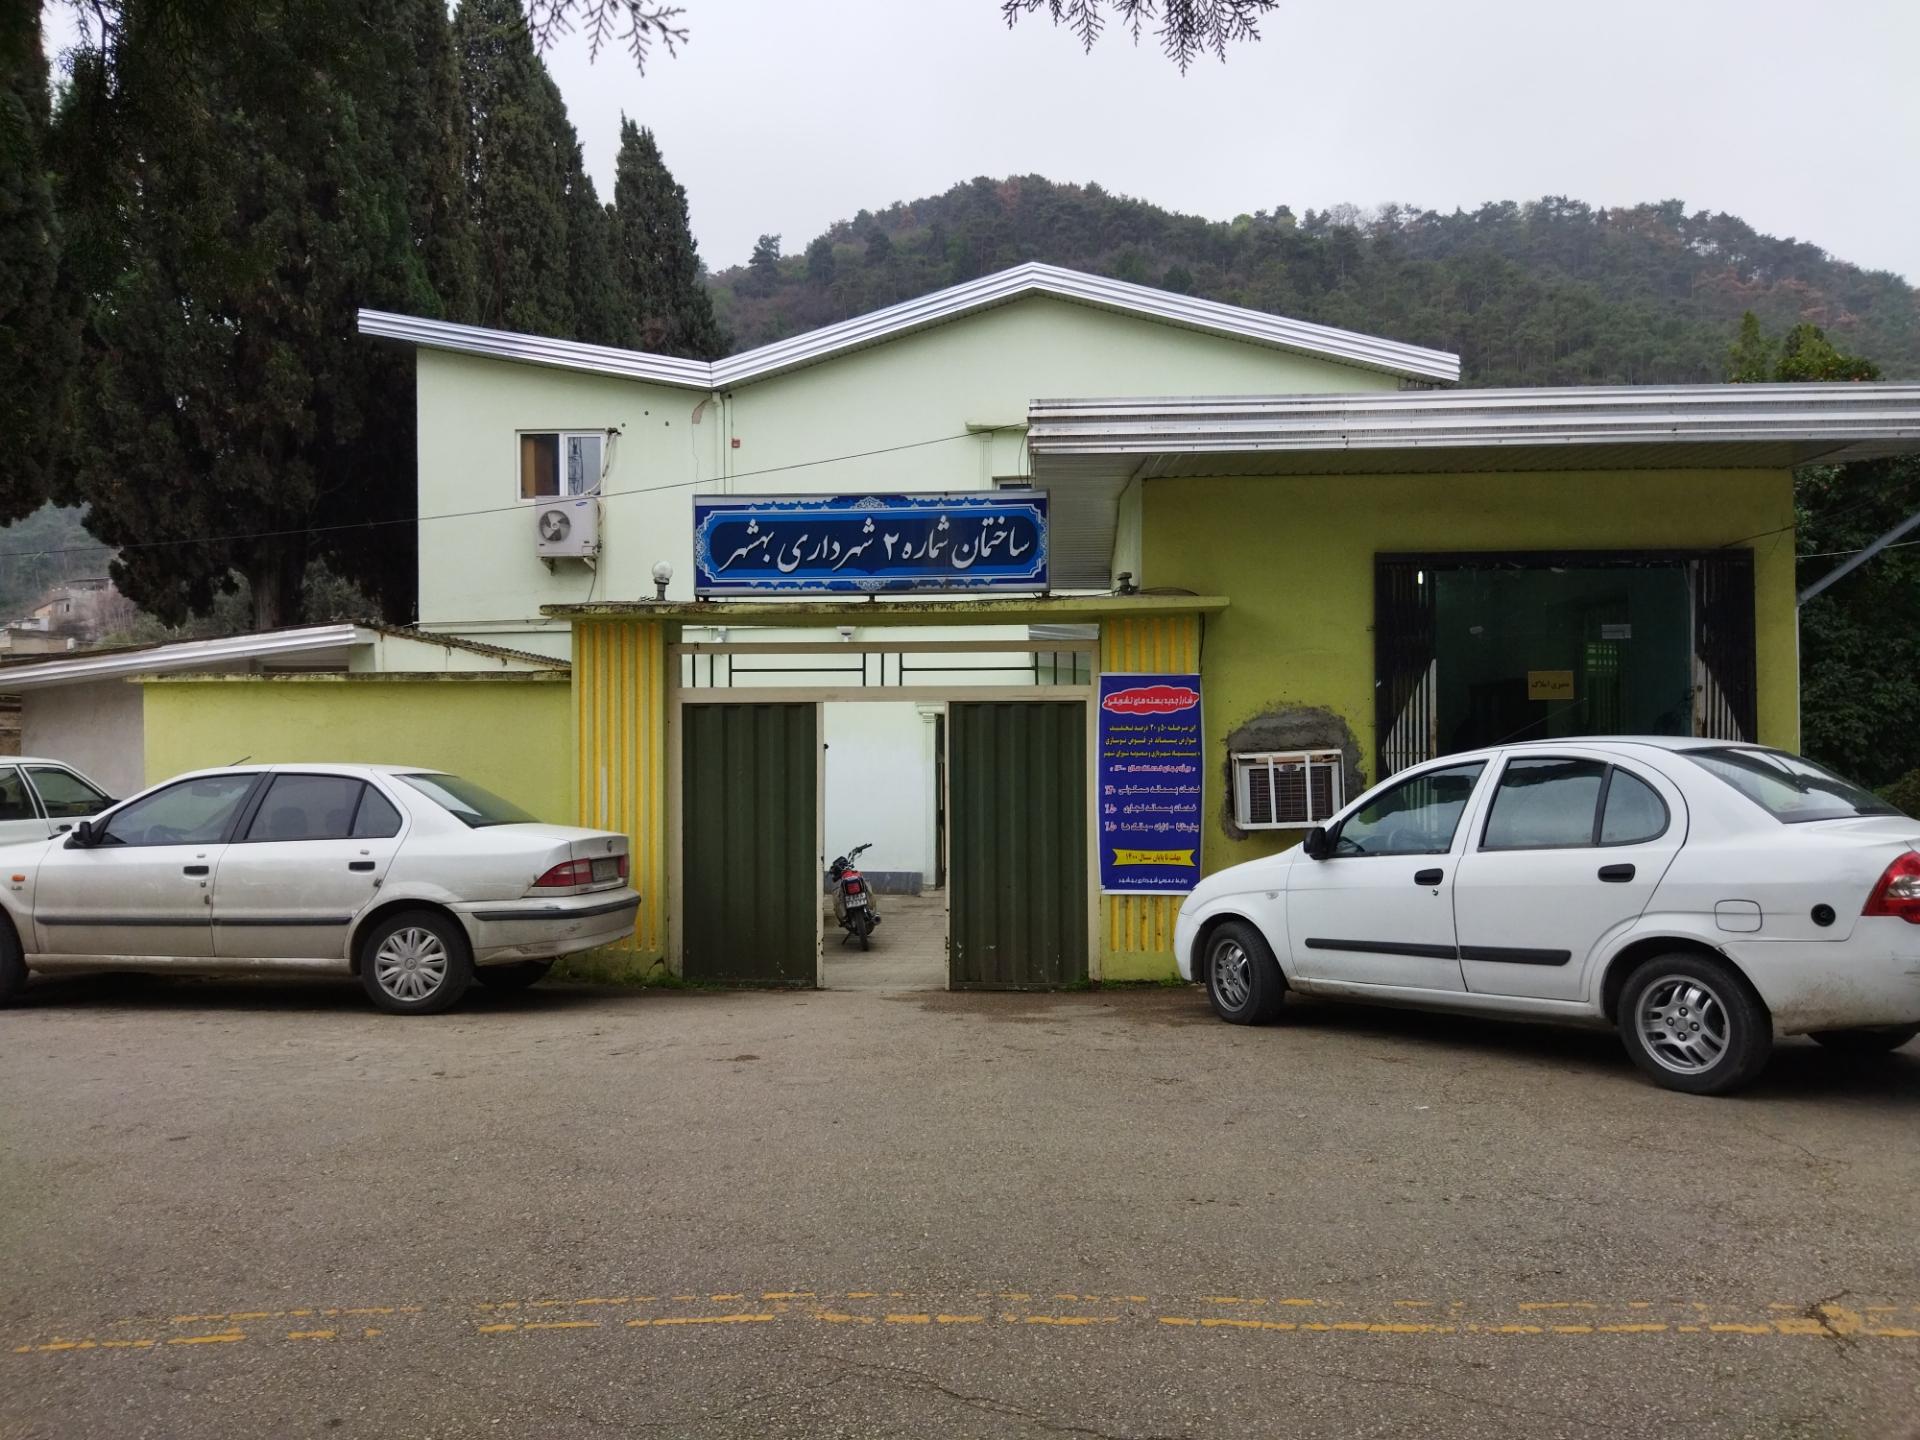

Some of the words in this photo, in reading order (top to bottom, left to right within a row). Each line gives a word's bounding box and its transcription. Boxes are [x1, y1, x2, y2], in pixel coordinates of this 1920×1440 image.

[718, 518, 776, 573] بهشهر
[776, 517, 875, 573] شهرداری
[883, 531, 900, 561] ۲
[902, 514, 951, 561] شماره
[951, 514, 1030, 570] ساختمان
[1134, 696, 1146, 706] های
[1146, 696, 1164, 706] بسته
[1164, 696, 1178, 706] جدید
